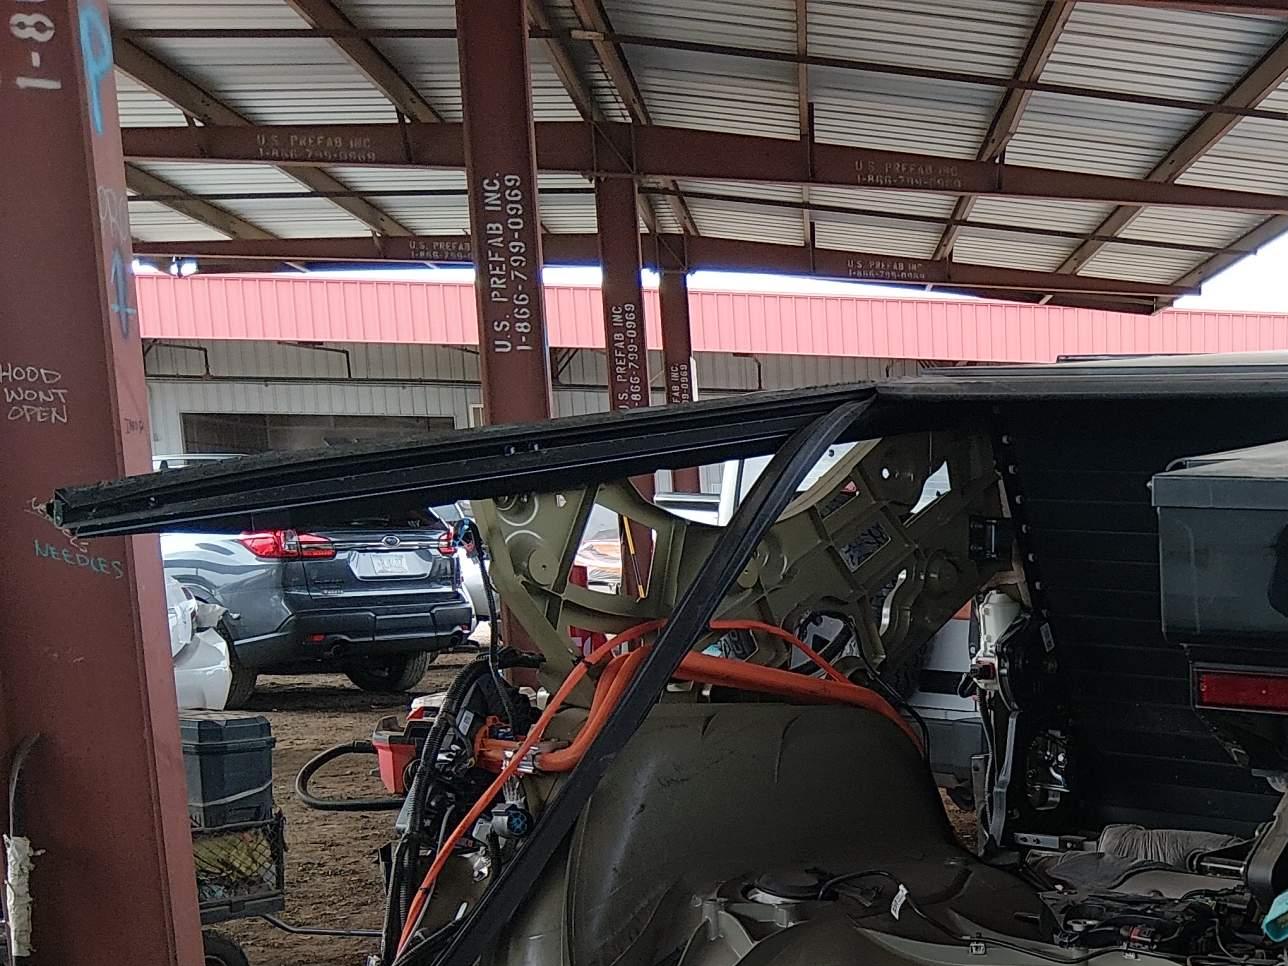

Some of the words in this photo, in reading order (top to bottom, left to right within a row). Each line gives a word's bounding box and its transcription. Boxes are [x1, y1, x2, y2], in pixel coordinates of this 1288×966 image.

[9, 0, 62, 90] 1-8
[290, 135, 343, 148] PREFAB
[483, 172, 502, 211] INC.
[486, 222, 509, 302] PREFAB
[504, 174, 533, 351] 1-866-799-0969
[494, 314, 512, 353] U.S.
[0, 362, 62, 384] HOOD
[613, 333, 628, 382] PREFAB
[624, 303, 642, 407] -866-799-0969
[4, 387, 69, 404] WONT
[7, 404, 69, 424] OPEN
[671, 385, 681, 404] FAB
